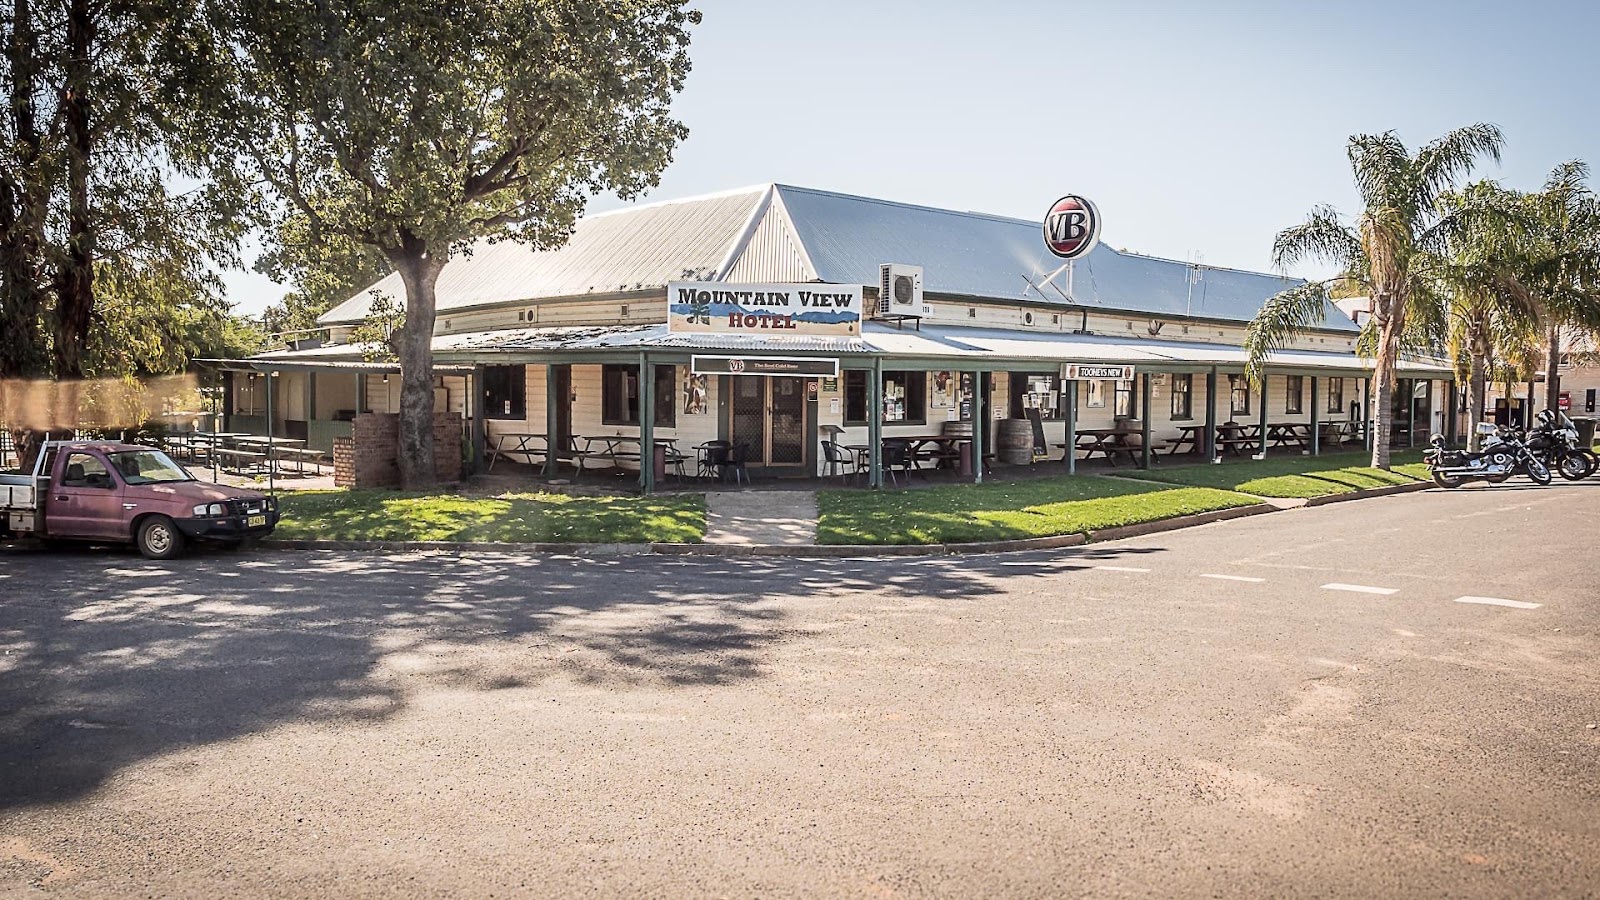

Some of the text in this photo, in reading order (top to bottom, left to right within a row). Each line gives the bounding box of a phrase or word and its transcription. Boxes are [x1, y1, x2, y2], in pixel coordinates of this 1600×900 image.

[1049, 212, 1086, 241] VB
[678, 288, 853, 307] MOUNTAIN VIEW
[729, 312, 796, 329] HOTEL
[730, 361, 743, 370] VB
[1080, 368, 1122, 377] TOOHEYS NEW
